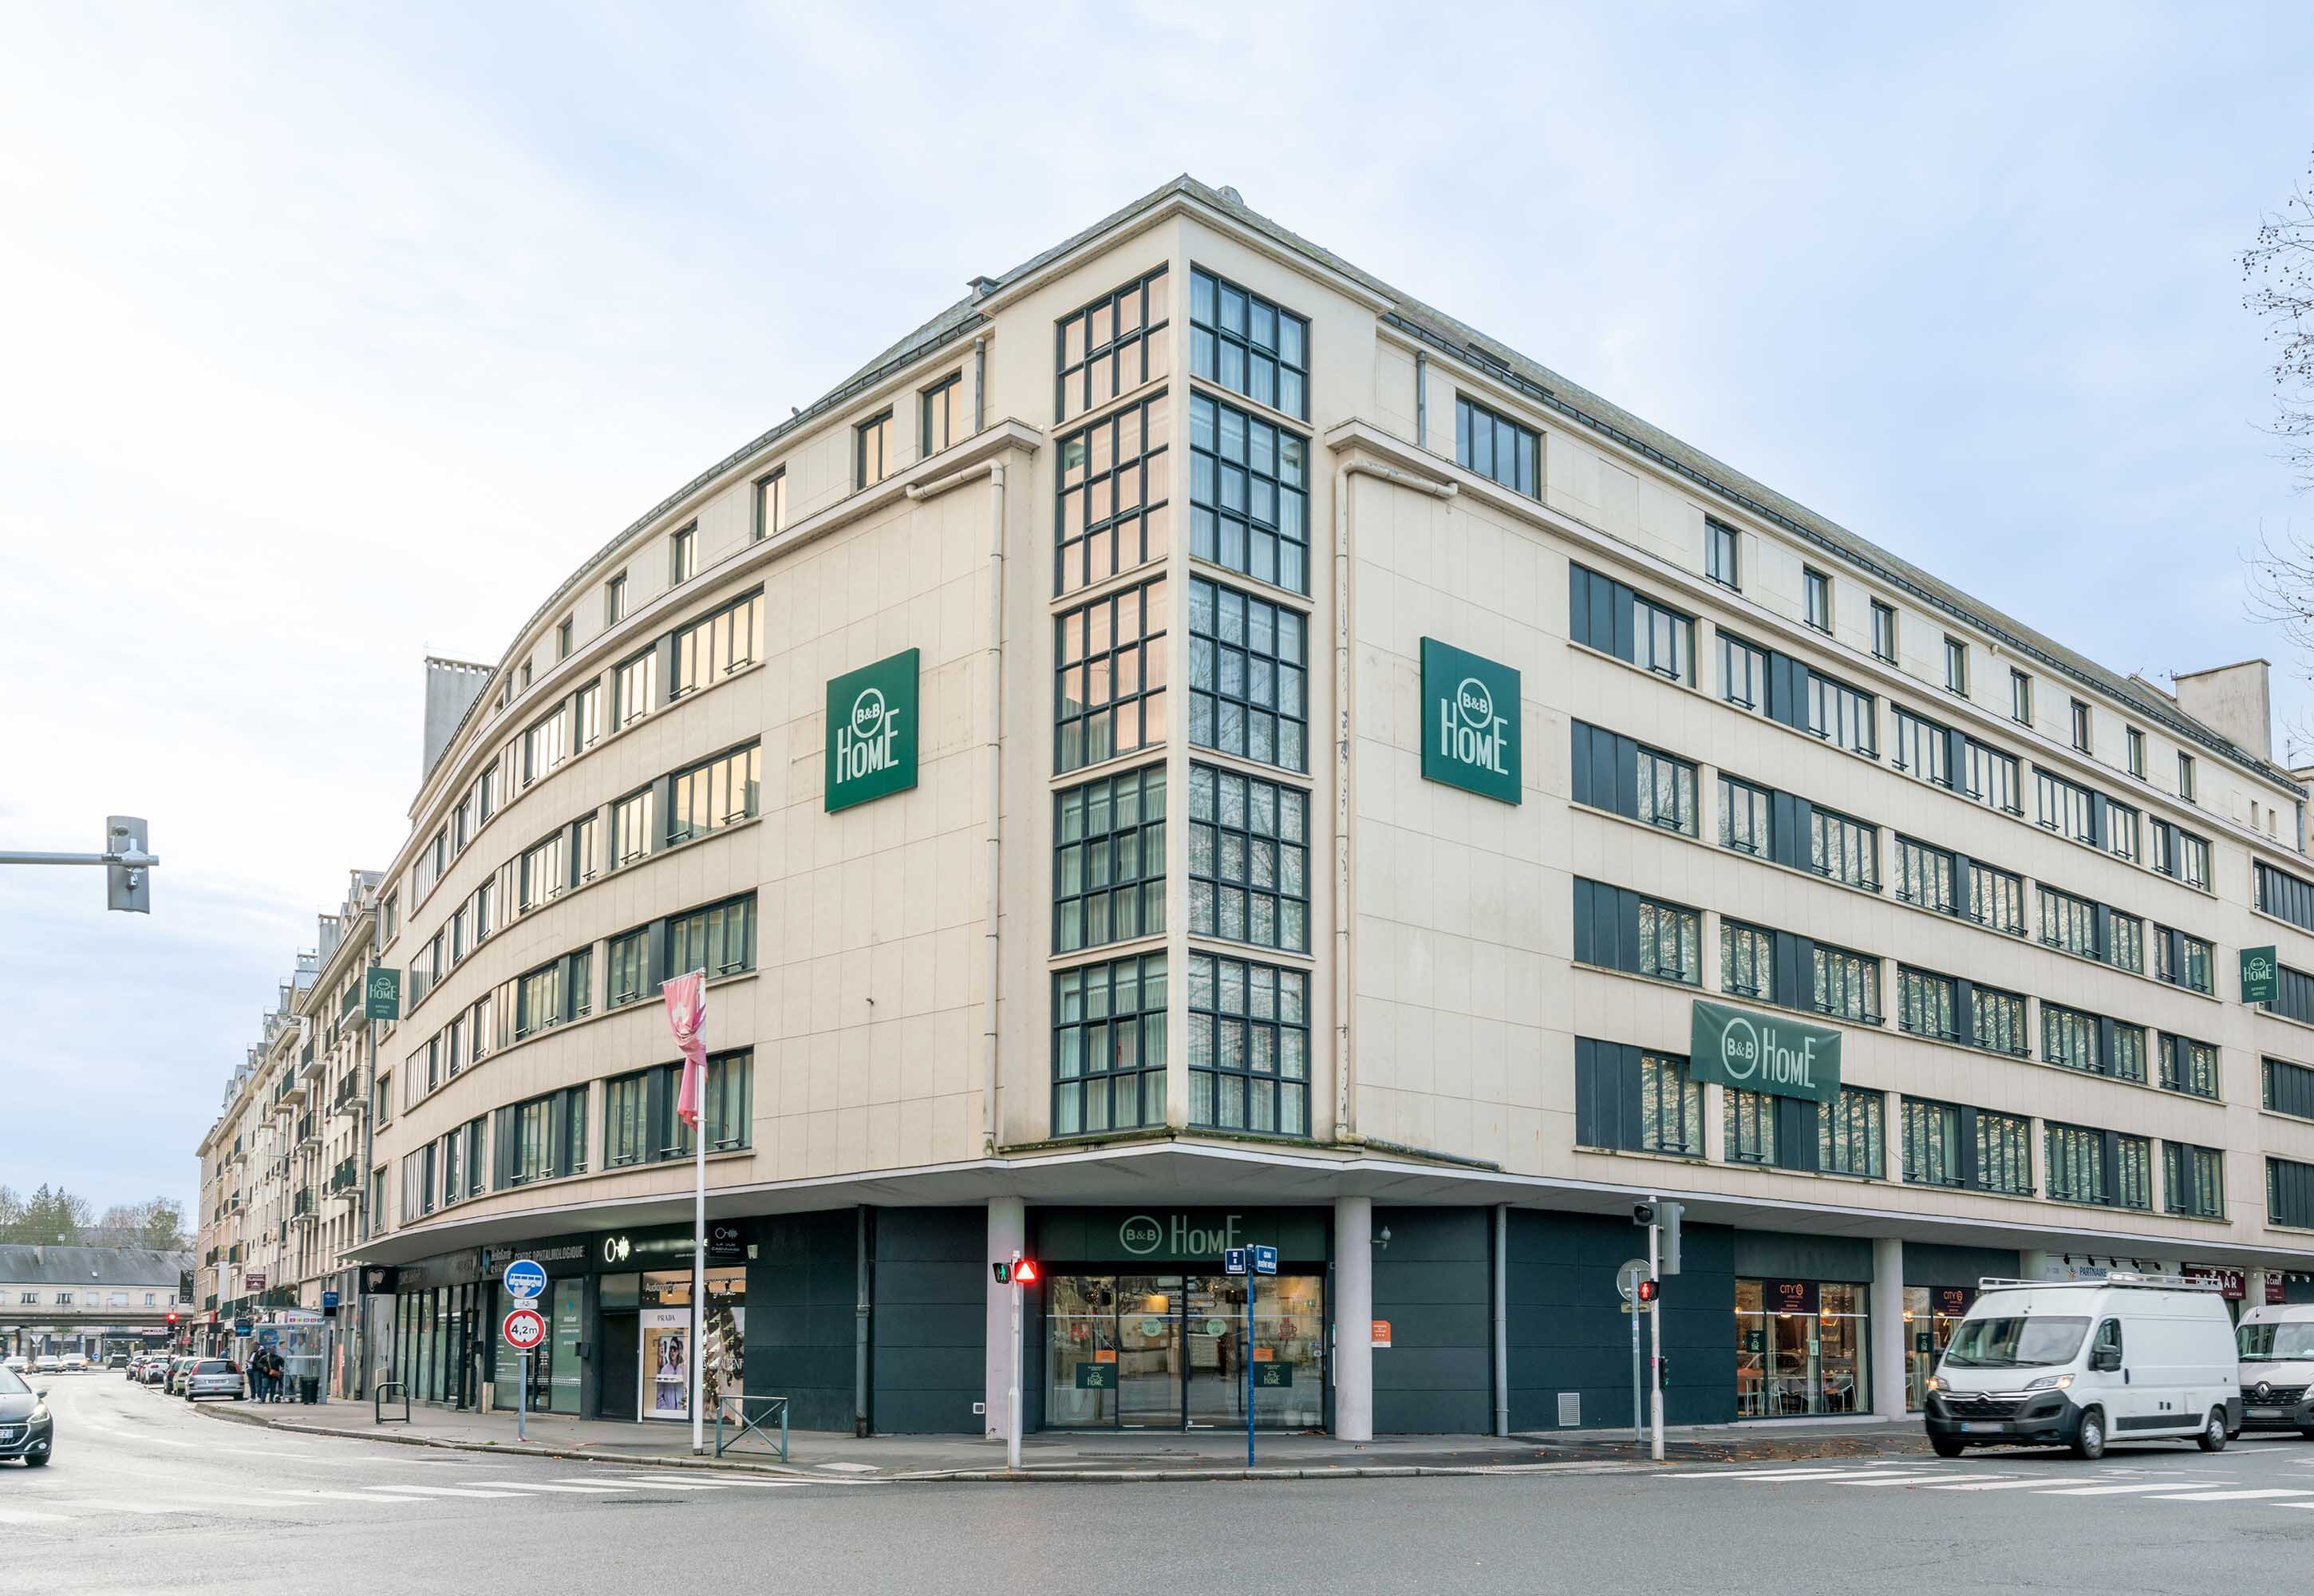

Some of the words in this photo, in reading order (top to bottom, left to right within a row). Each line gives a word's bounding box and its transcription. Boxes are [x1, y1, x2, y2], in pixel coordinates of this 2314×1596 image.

[856, 703, 881, 724] B&B
[1463, 692, 1488, 714] B&B
[836, 708, 900, 784] HOME
[1441, 697, 1509, 775] HOME
[2243, 963, 2273, 982] HOME
[369, 983, 397, 1000] HOME
[1727, 1037, 1755, 1059] B&B
[1762, 1027, 1816, 1088] HOME
[1126, 1229, 1156, 1241] B&B
[1171, 1215, 1242, 1254] HOME
[2079, 1266, 2107, 1278] PARTNAIRE
